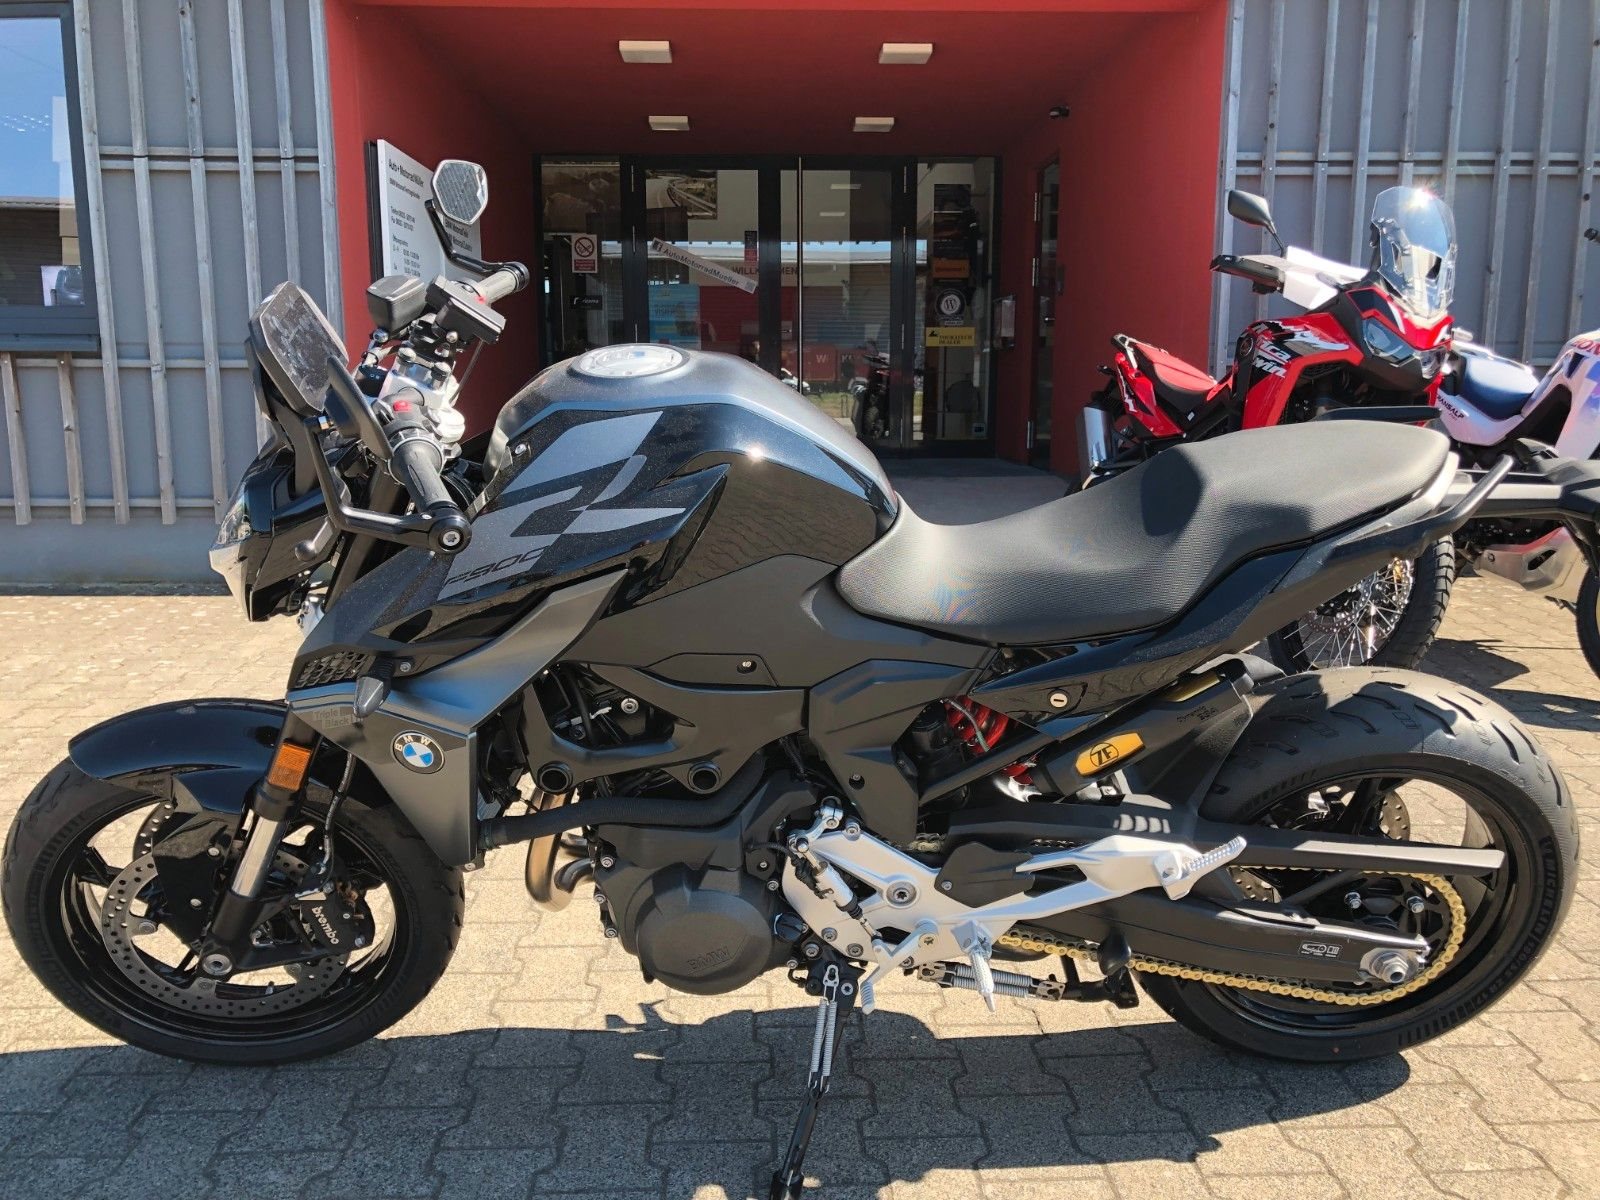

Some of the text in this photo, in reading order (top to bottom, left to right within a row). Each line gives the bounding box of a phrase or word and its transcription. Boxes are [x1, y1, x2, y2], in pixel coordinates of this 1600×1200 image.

[314, 709, 338, 719] Triple
[325, 718, 349, 728] Black
[395, 735, 431, 751] BMW
[1091, 748, 1113, 766] ZF
[311, 906, 340, 944] brembo
[687, 945, 730, 970] BMW
